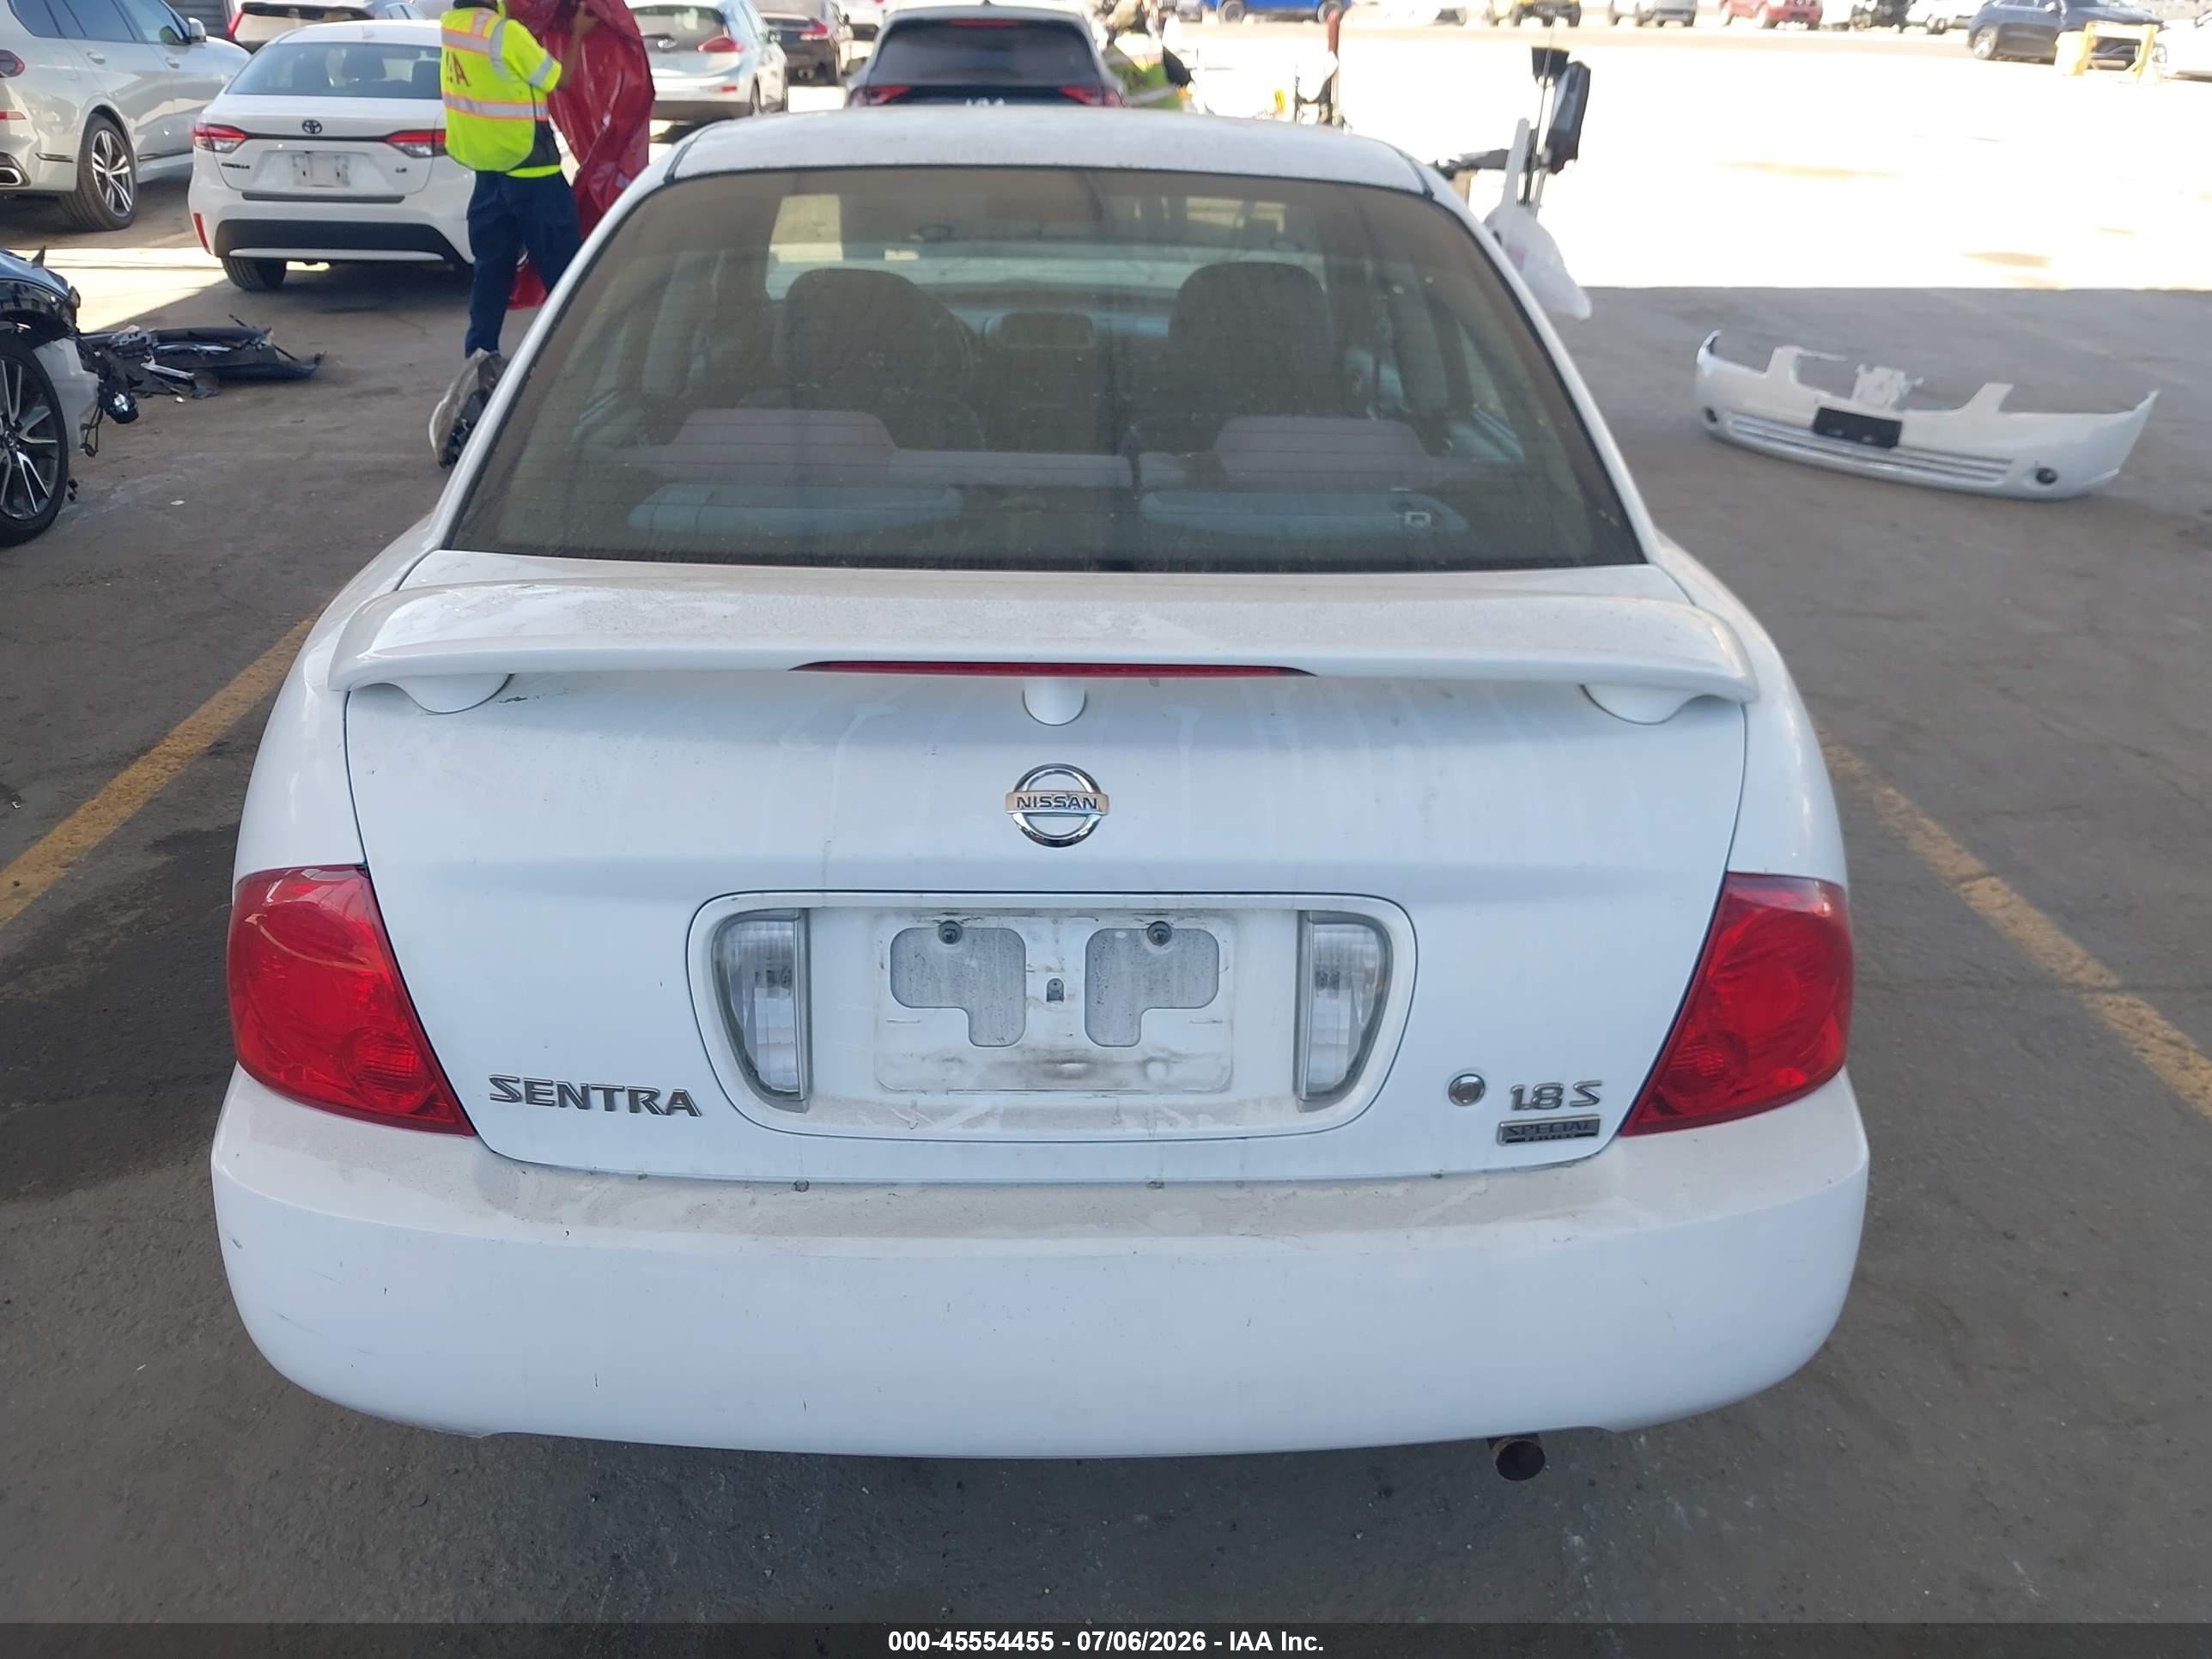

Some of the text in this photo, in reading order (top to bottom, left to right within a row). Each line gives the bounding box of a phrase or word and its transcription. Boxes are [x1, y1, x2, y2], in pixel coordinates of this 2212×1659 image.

[1017, 795, 1097, 809] NISSAN
[489, 1074, 702, 1117] SENTRA
[1504, 1119, 1595, 1140] SPECIAL
